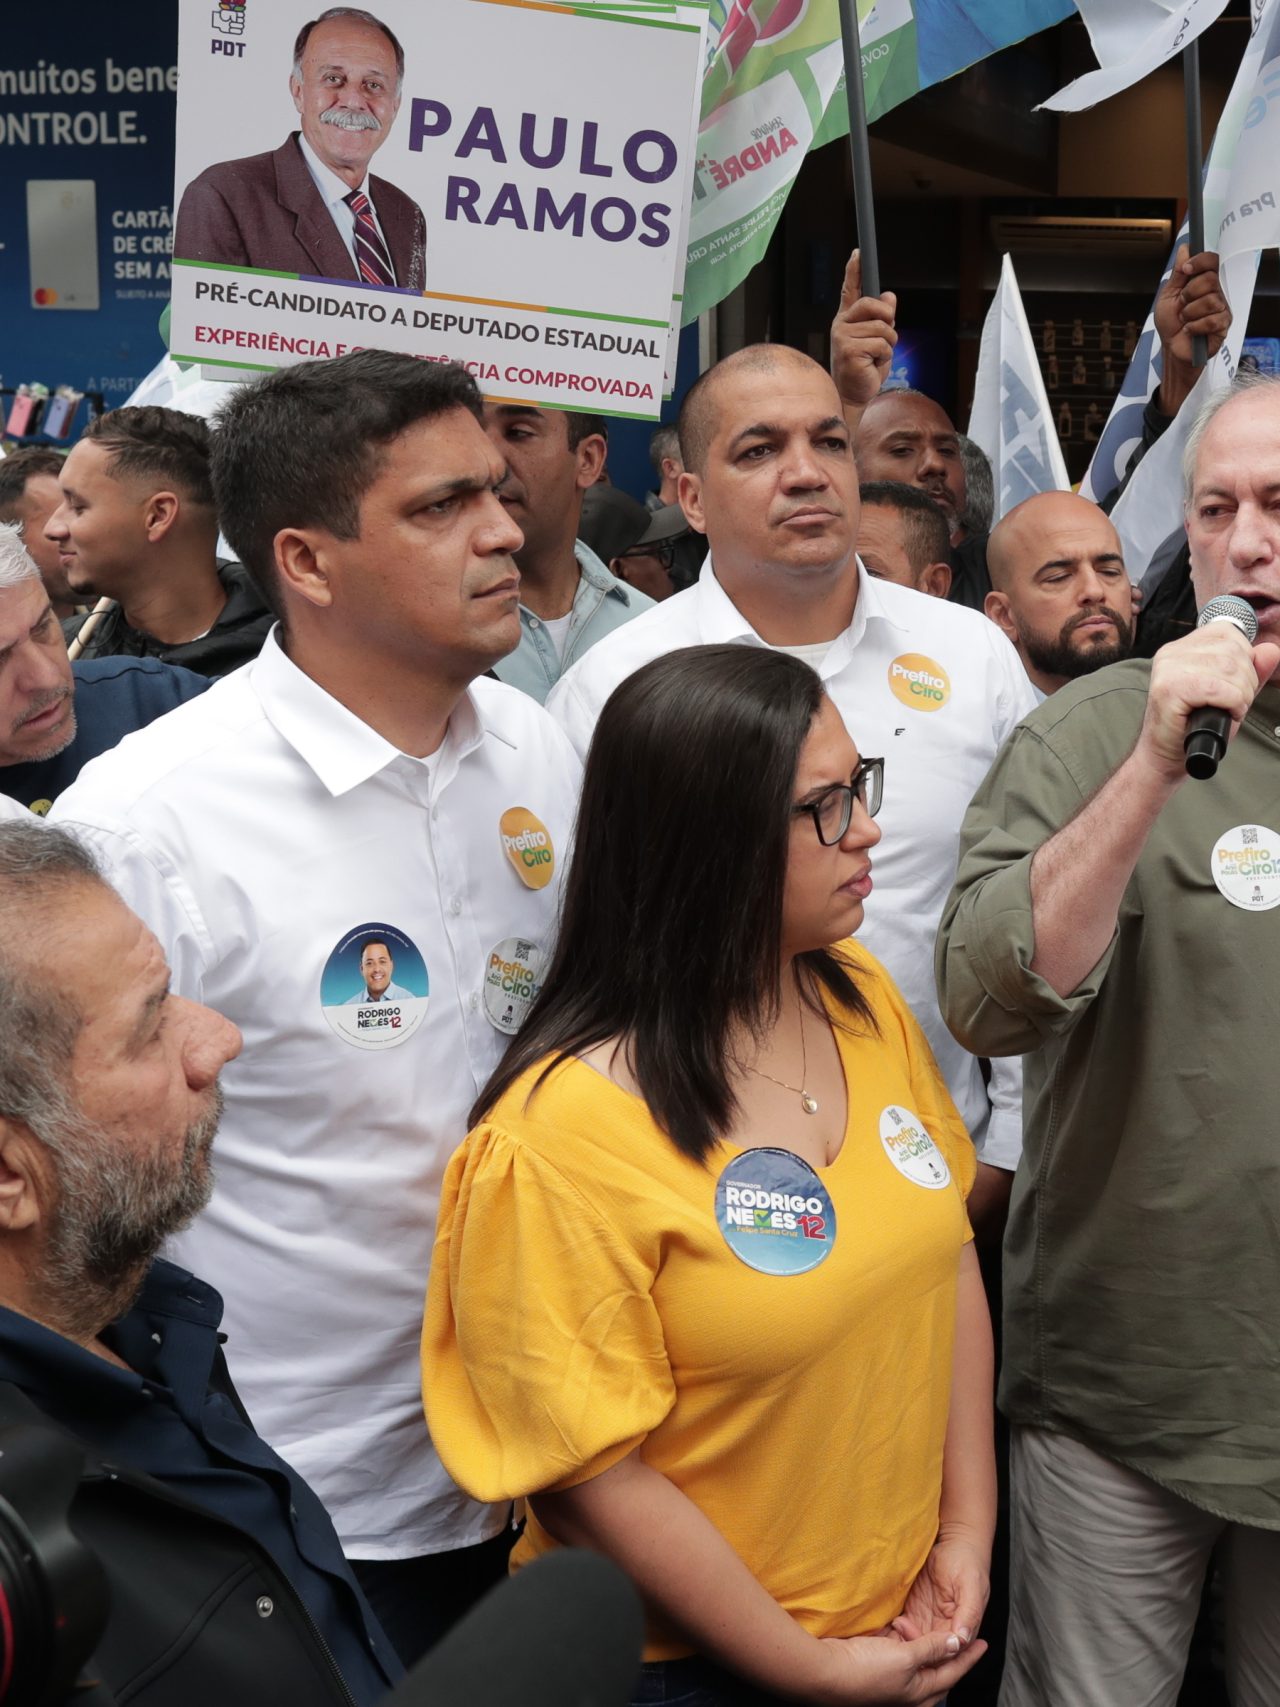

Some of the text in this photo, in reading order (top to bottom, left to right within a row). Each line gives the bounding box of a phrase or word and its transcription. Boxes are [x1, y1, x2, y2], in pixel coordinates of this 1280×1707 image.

[211, 39, 246, 58] PDT
[105, 57, 177, 93] bene
[408, 97, 678, 184] PAULO
[112, 206, 173, 229] CARTÃ
[445, 175, 672, 248] RAMOS
[113, 231, 173, 254] DE CRÉ
[114, 260, 152, 279] SEM
[195, 281, 660, 359] PRÉ-CANDIDATO A DEPUTADO ESTADUAL
[195, 325, 332, 358] EXPERIÊNCIA
[504, 365, 655, 400] COMPROVADA
[892, 663, 945, 688] Prefiro
[910, 681, 944, 701] Ciro
[503, 830, 547, 852] Prefiro
[521, 847, 552, 867] Ciro
[1217, 847, 1270, 863] Prefiro
[490, 953, 534, 982] Prefiro
[357, 1007, 401, 1019] RODRIGO
[389, 1016, 401, 1028] 12
[885, 1127, 918, 1151] Prefiro
[726, 1186, 823, 1215] RODRIGO
[796, 1215, 827, 1240] 12
